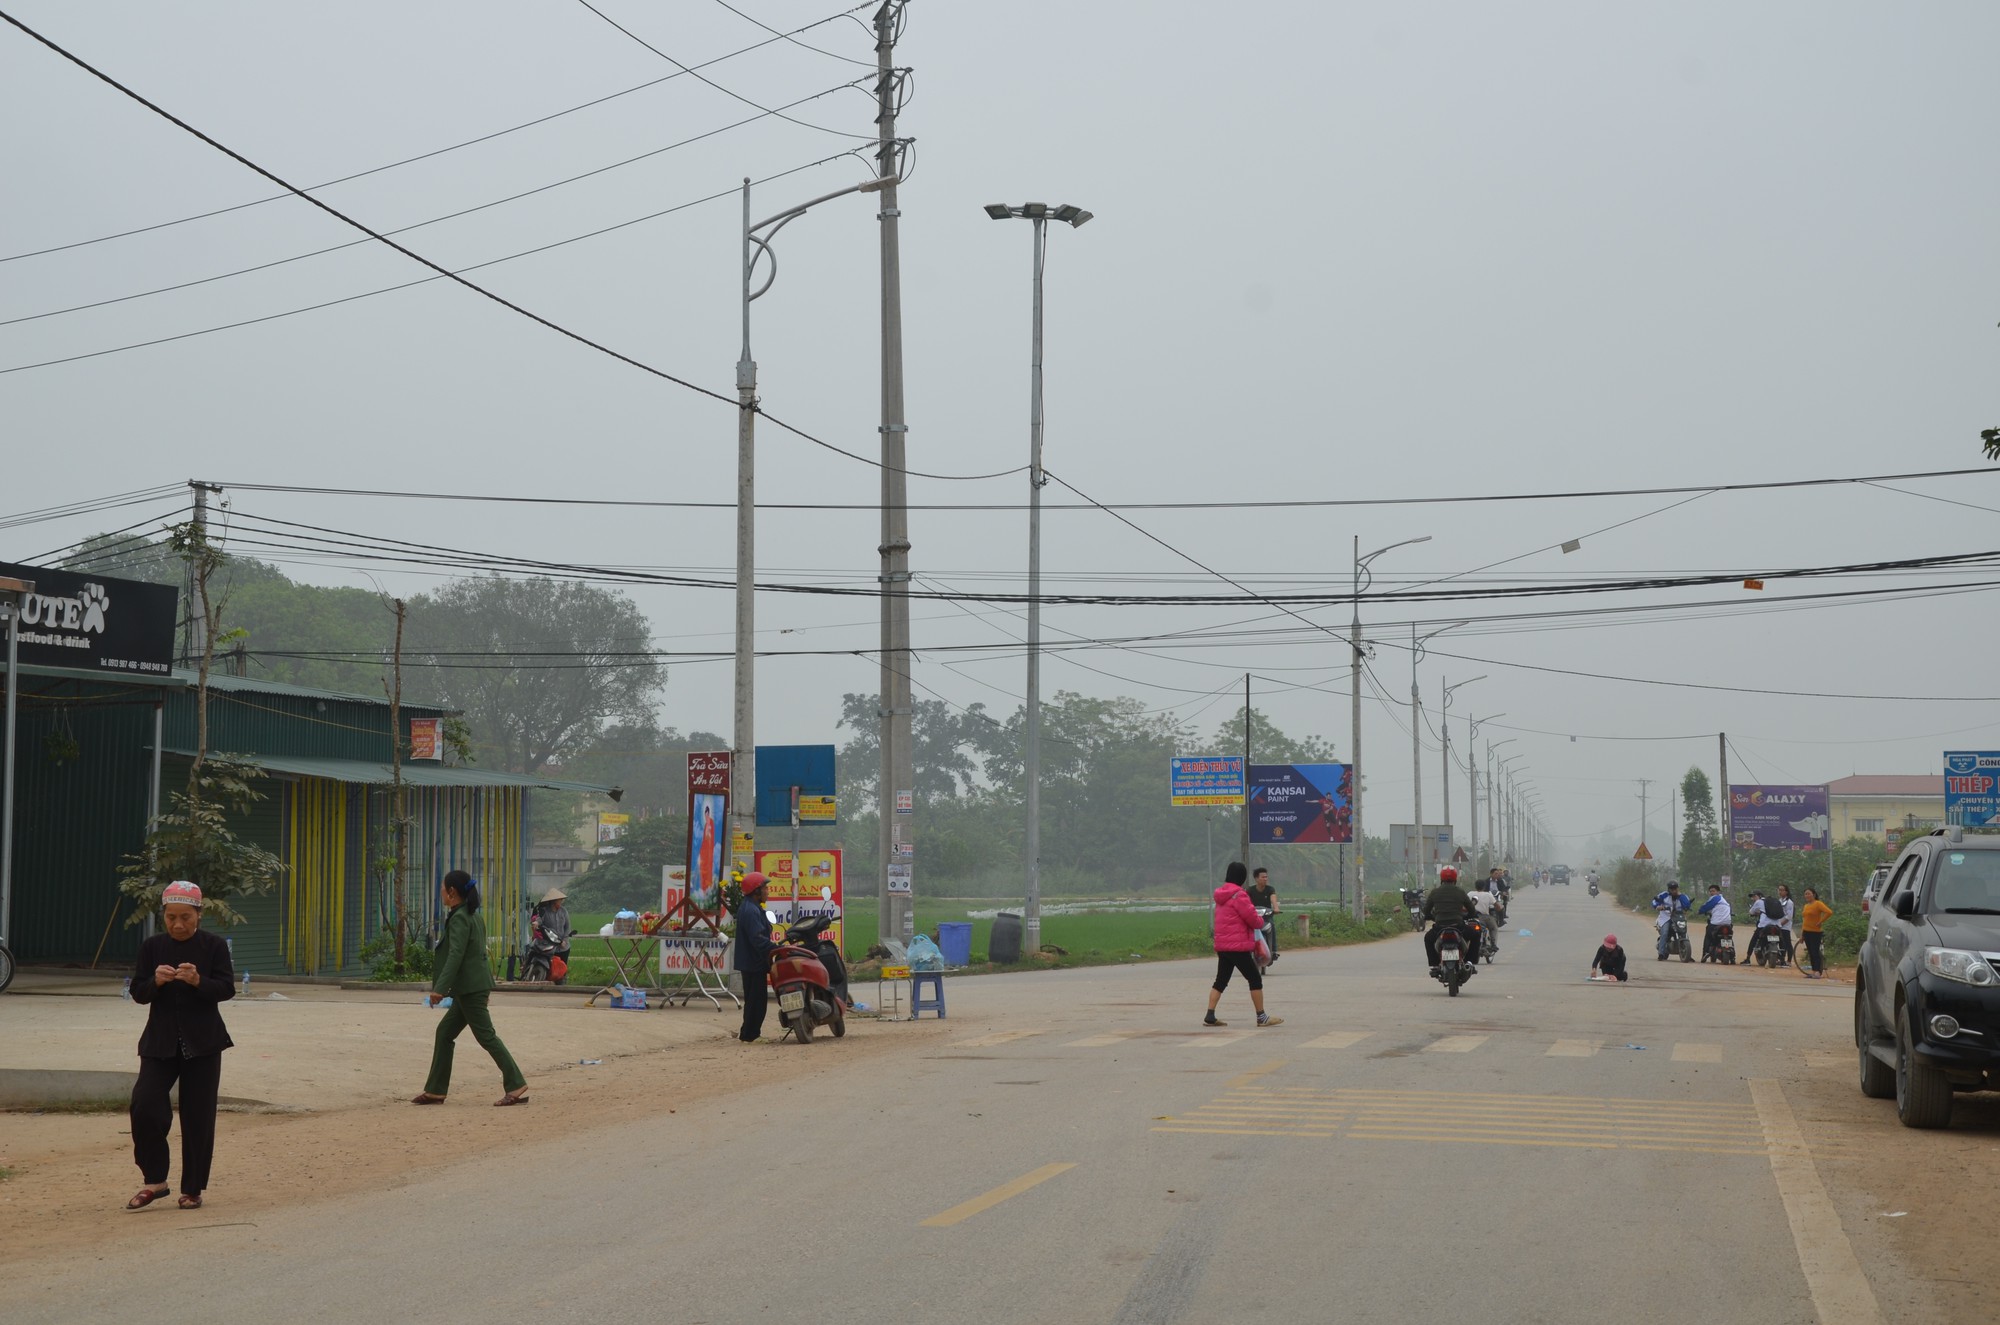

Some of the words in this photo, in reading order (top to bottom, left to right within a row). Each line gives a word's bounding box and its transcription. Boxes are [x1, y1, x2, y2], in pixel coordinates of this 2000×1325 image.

[65, 636, 90, 649] drink
[690, 758, 706, 770] Trà
[1181, 762, 1191, 773] XE
[1267, 787, 1306, 796] KANSAI
[666, 951, 681, 969] CÁC
